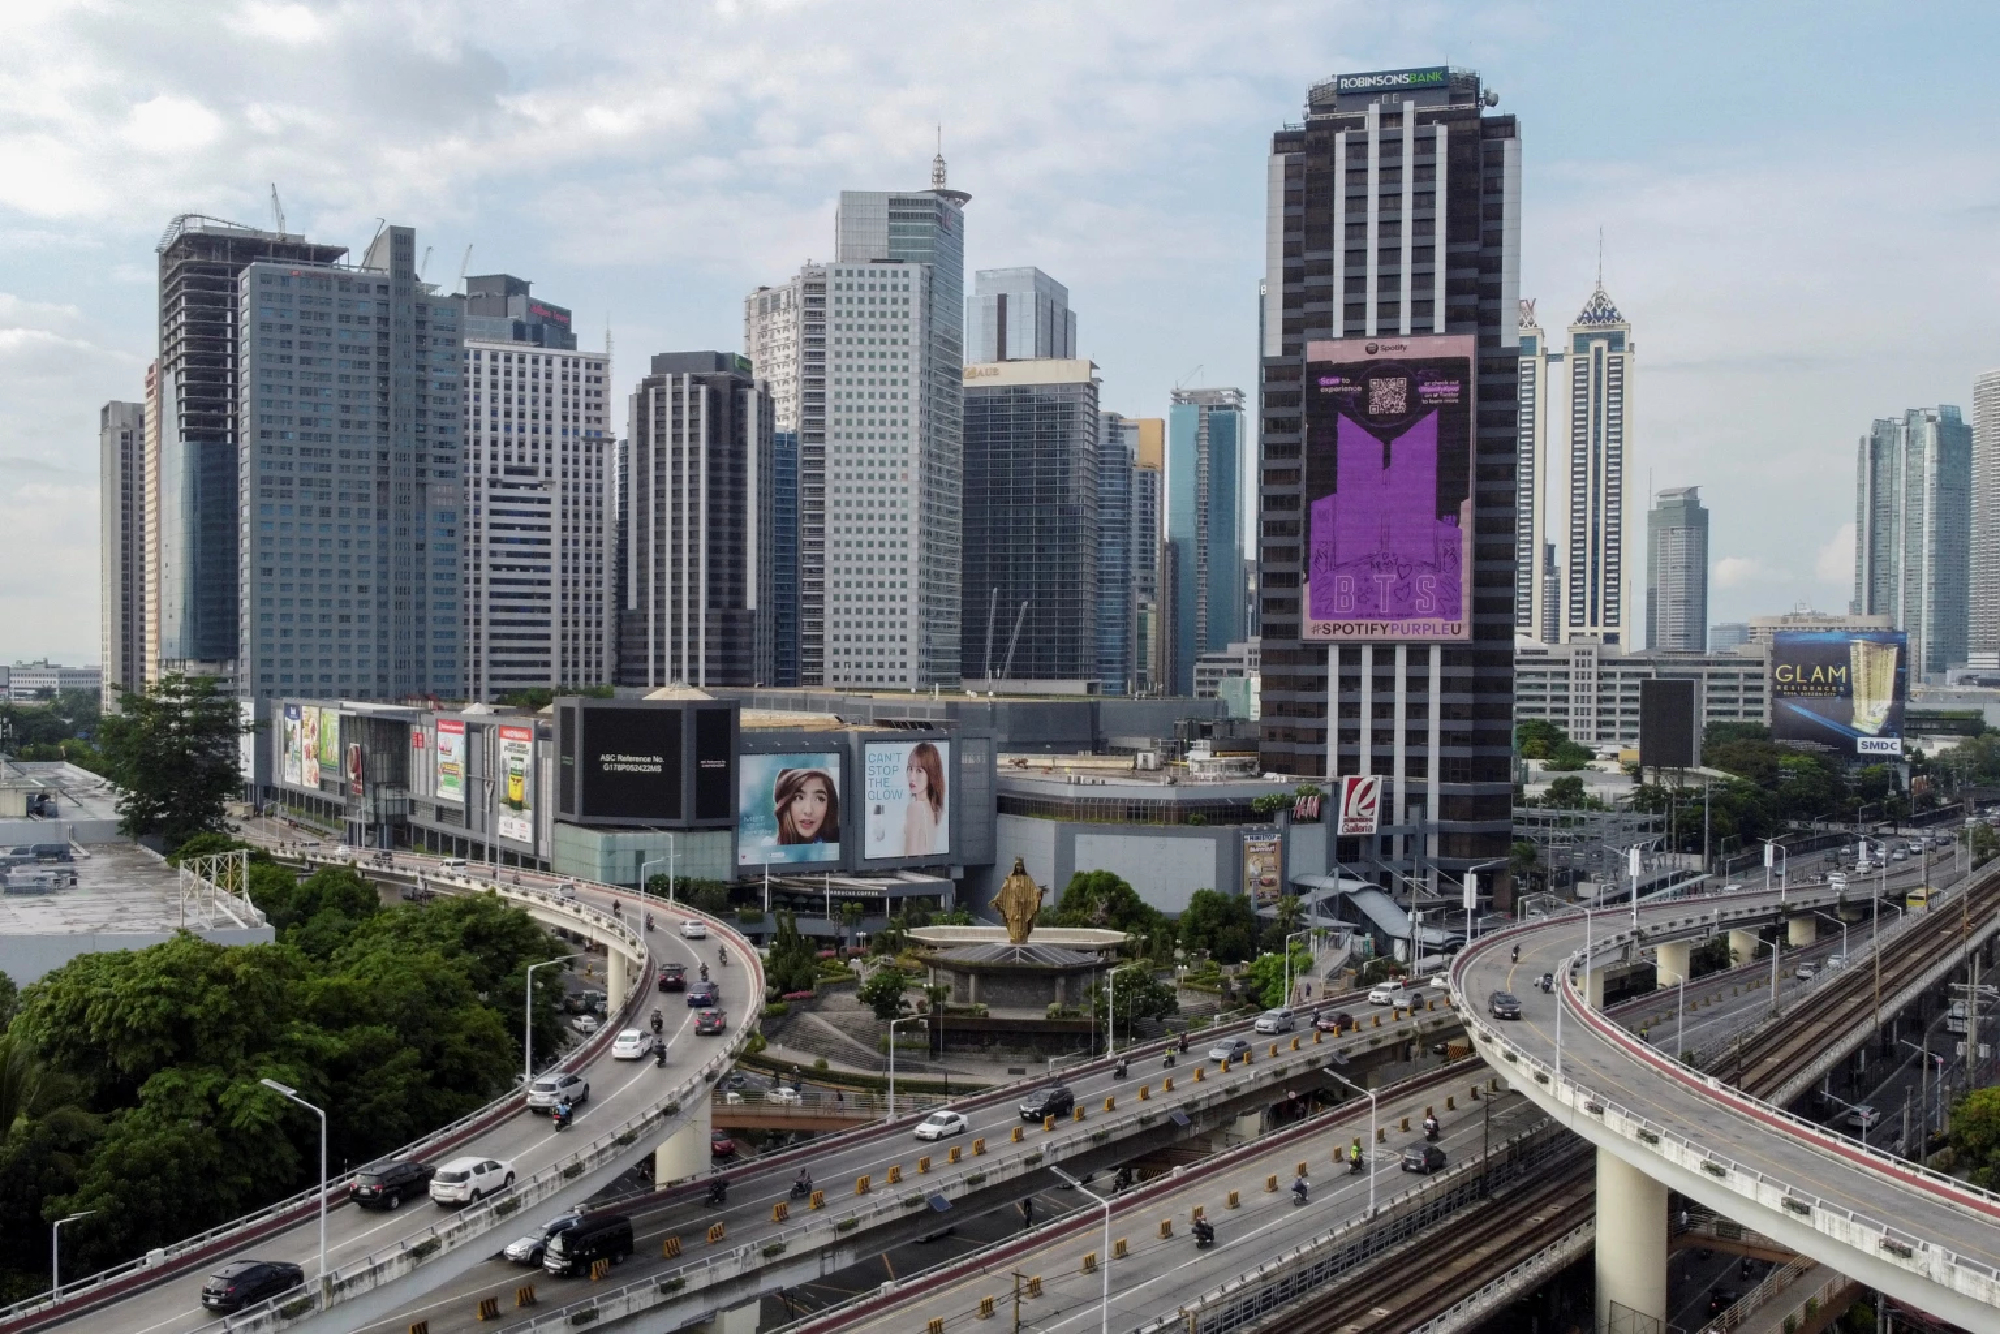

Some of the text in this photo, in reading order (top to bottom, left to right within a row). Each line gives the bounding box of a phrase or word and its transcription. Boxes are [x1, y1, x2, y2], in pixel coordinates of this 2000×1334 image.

[1380, 344, 1408, 353] Spotify
[1334, 574, 1437, 613] BTS
[1310, 622, 1463, 635] #SPOTIFYPURPLEU
[1775, 664, 1846, 684] GLAM
[1776, 684, 1845, 692] RESIDENCES
[1860, 740, 1898, 751] SMDC
[600, 753, 664, 763] ASC Reference No.
[868, 752, 903, 763] CAN'T
[868, 765, 900, 776] STOP
[868, 777, 891, 788] THE
[867, 789, 904, 801] GLOW
